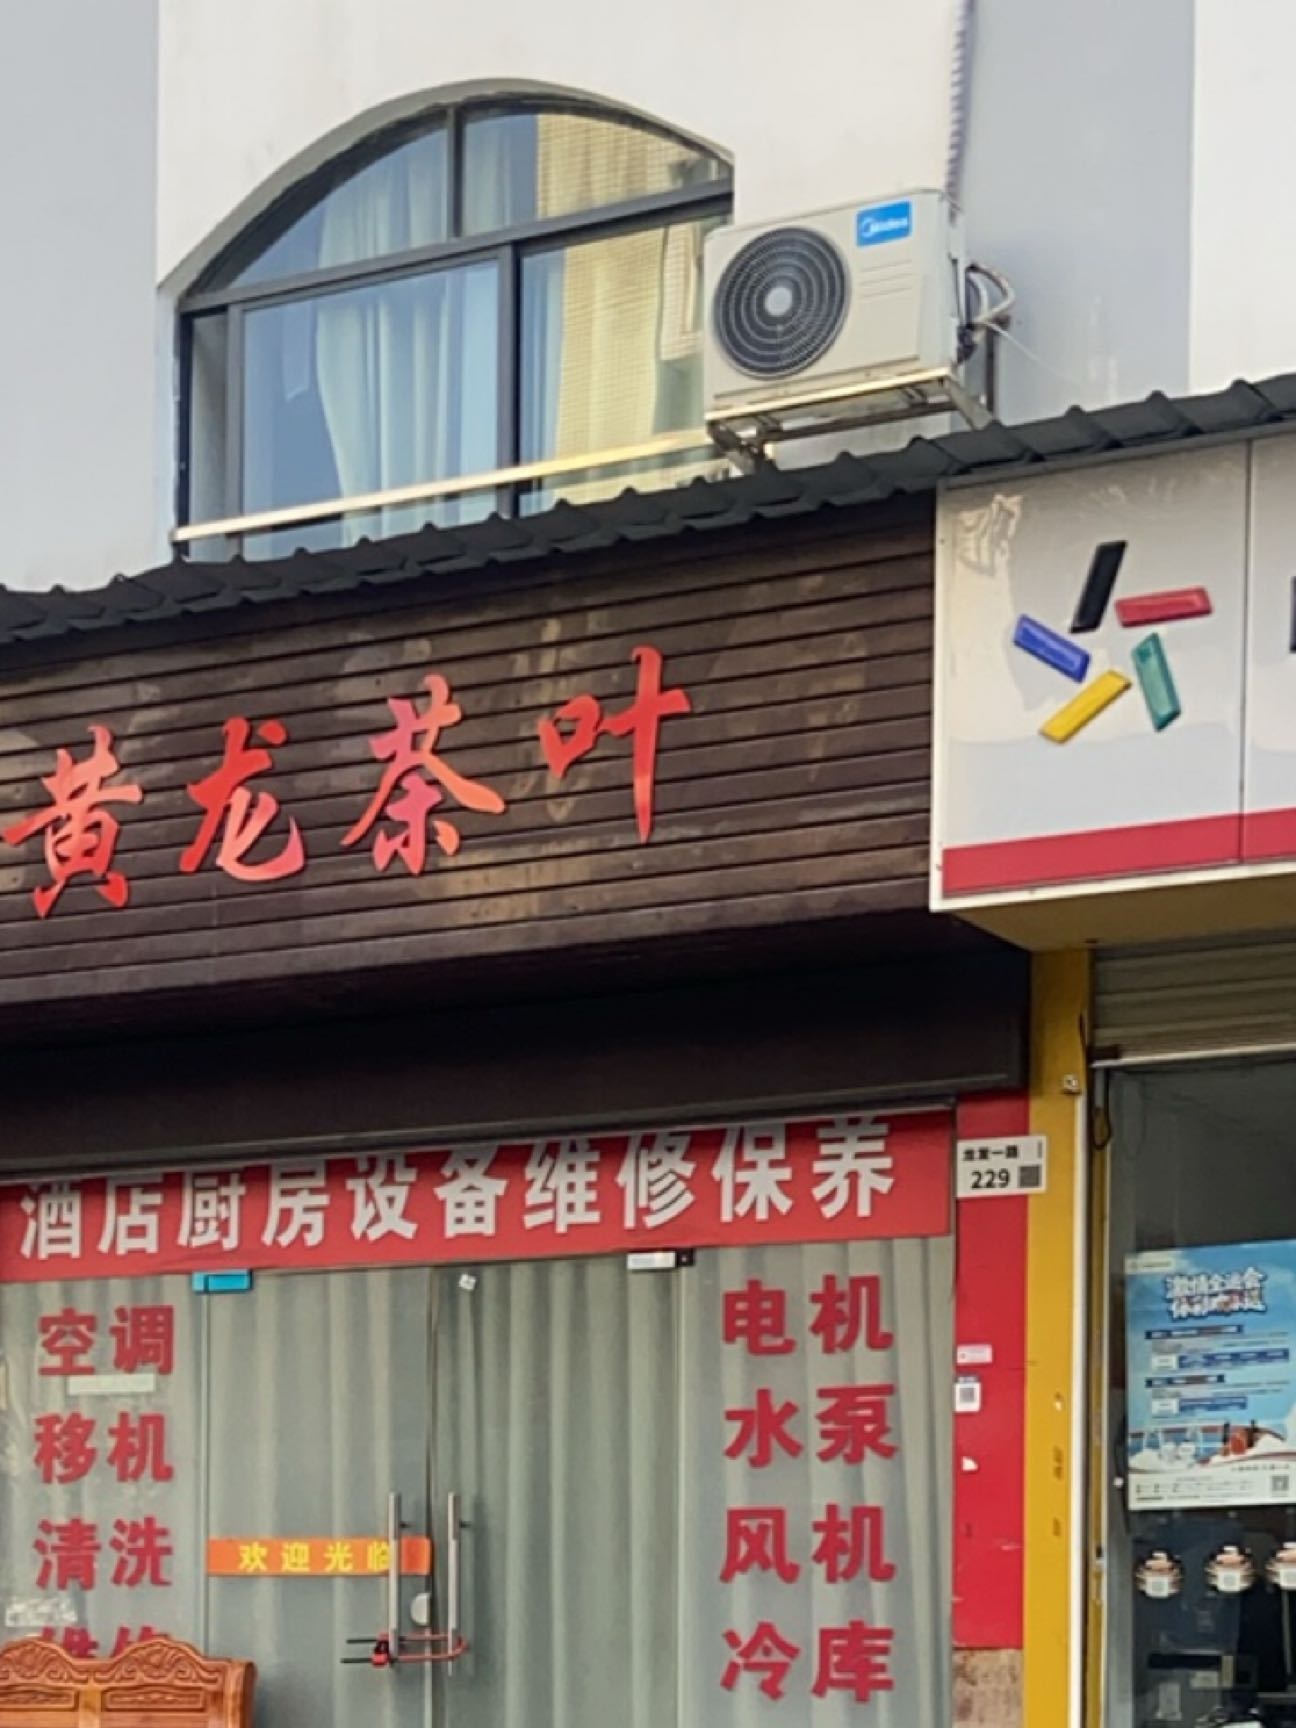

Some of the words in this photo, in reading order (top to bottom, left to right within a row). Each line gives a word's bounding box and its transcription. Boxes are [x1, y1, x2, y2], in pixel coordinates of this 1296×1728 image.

[4, 645, 691, 919] 黄龙茶叶
[20, 1115, 894, 1261] 酒店厨房设备维修保养
[971, 1168, 1011, 1192] 229
[38, 1305, 175, 1376] 空调
[721, 1274, 894, 1356] 电机
[34, 1411, 175, 1485] 移机
[724, 1384, 897, 1469] 水泵
[34, 1517, 173, 1591] 清洗
[239, 1540, 392, 1573] 欢迎光临
[720, 1504, 895, 1584] 风机
[720, 1620, 895, 1703] 冷库
